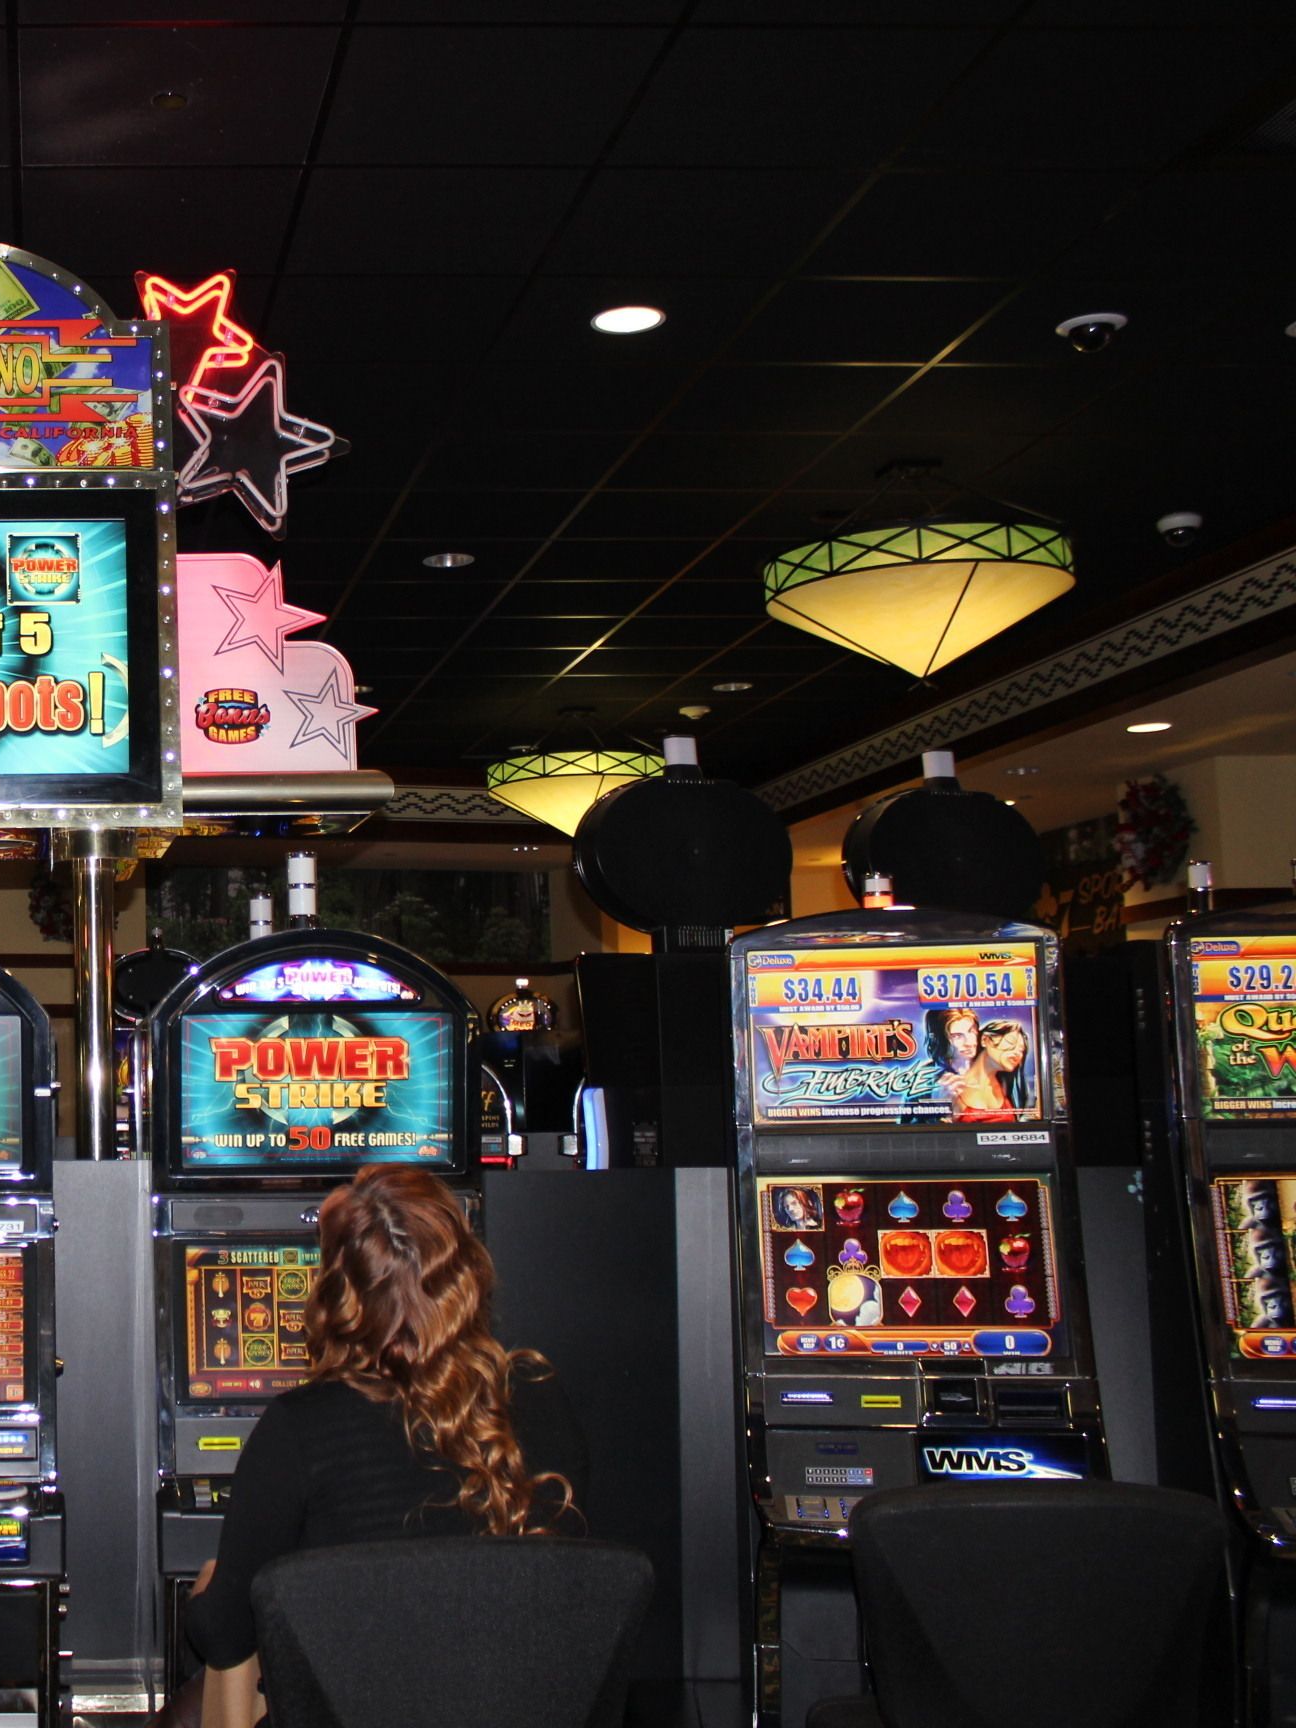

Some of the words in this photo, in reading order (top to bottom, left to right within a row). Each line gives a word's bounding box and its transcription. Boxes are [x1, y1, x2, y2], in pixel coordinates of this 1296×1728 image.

[0, 427, 139, 439] CALIFORNIA
[10, 557, 79, 574] POWER
[19, 612, 53, 656] 5
[207, 688, 256, 703] FREE
[195, 702, 271, 729] Bonus
[208, 726, 257, 743] GAMES
[762, 956, 792, 965] Deluxe
[979, 952, 1013, 960] WMS
[784, 977, 858, 1002] $34.44
[922, 973, 1013, 998] $370.54
[757, 1020, 918, 1079] VAMPIRE'S
[1232, 1040, 1251, 1052] of
[208, 1037, 410, 1082] POWER
[1229, 1053, 1257, 1066] the
[235, 1082, 388, 1108] STRIKE
[768, 1107, 798, 1117] BIGGER
[799, 1107, 821, 1116] WINS
[861, 1106, 911, 1117] progressive
[912, 1104, 952, 1114] chances.
[215, 1133, 242, 1147] WIN
[246, 1134, 264, 1147] UP
[268, 1134, 286, 1147] TO
[288, 1126, 331, 1150] 50
[334, 1133, 365, 1146] FREE
[368, 1132, 416, 1146] GAMES!
[979, 1134, 1007, 1142] B24
[1012, 1133, 1046, 1142] 9684
[217, 1249, 229, 1265] 3
[230, 1251, 279, 1264] SCATTERED
[896, 1342, 904, 1350] 0
[944, 1342, 958, 1350] 50
[1005, 1336, 1016, 1350] 0
[923, 1448, 1027, 1474] WMS
